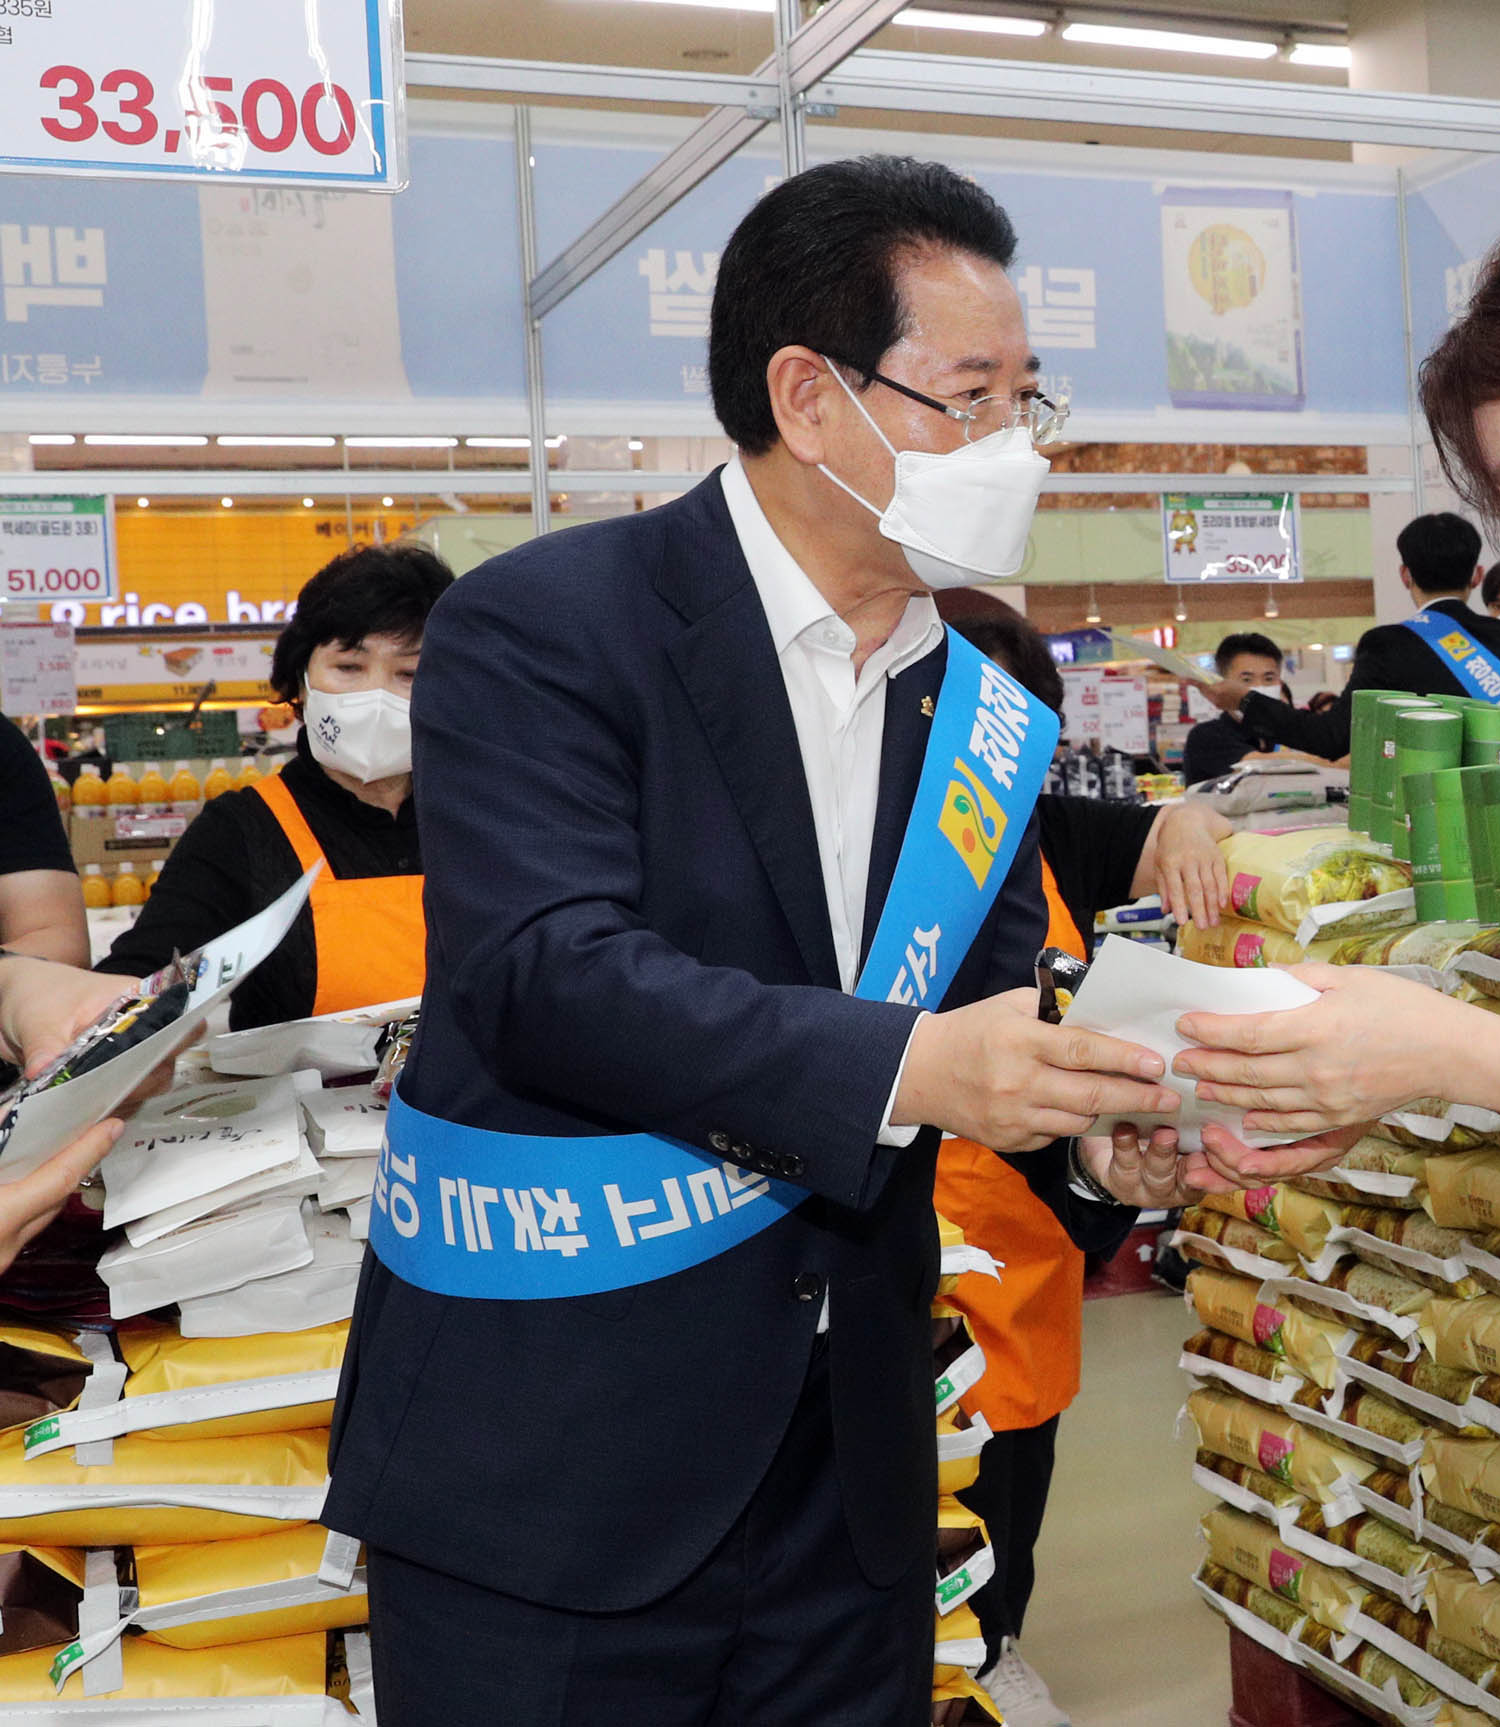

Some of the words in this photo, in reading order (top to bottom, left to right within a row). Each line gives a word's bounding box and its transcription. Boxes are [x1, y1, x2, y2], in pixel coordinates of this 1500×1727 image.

[39, 65, 356, 155] 33,500
[8, 568, 100, 593] 51,000
[100, 592, 208, 626] rice
[438, 1176, 590, 1257] 찾는
